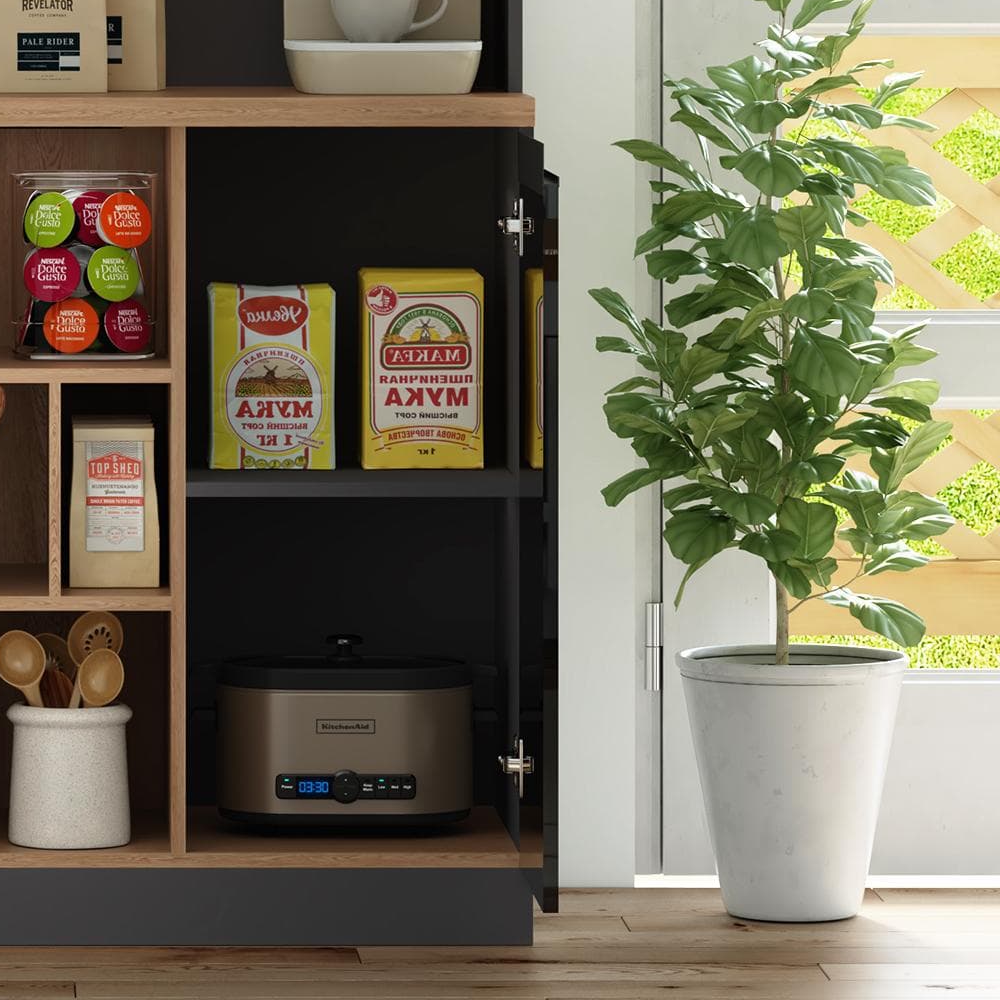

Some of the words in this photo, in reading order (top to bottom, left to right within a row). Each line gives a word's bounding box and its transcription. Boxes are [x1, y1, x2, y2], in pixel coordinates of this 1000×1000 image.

[22, 0, 73, 11] REVELATOR
[36, 210, 61, 220] Dolce
[113, 210, 140, 220] Dolce
[115, 219, 141, 227] Gusto
[38, 264, 67, 274] Dolce
[101, 264, 128, 273] Dolce
[37, 273, 67, 281] Gusto
[102, 273, 128, 281] Gusto
[56, 316, 86, 325] Dolce
[118, 316, 141, 325] Dolce
[56, 325, 85, 333] Gusto
[90, 462, 110, 474] TOP
[113, 462, 139, 475] SHED
[299, 782, 329, 792] 03:30
